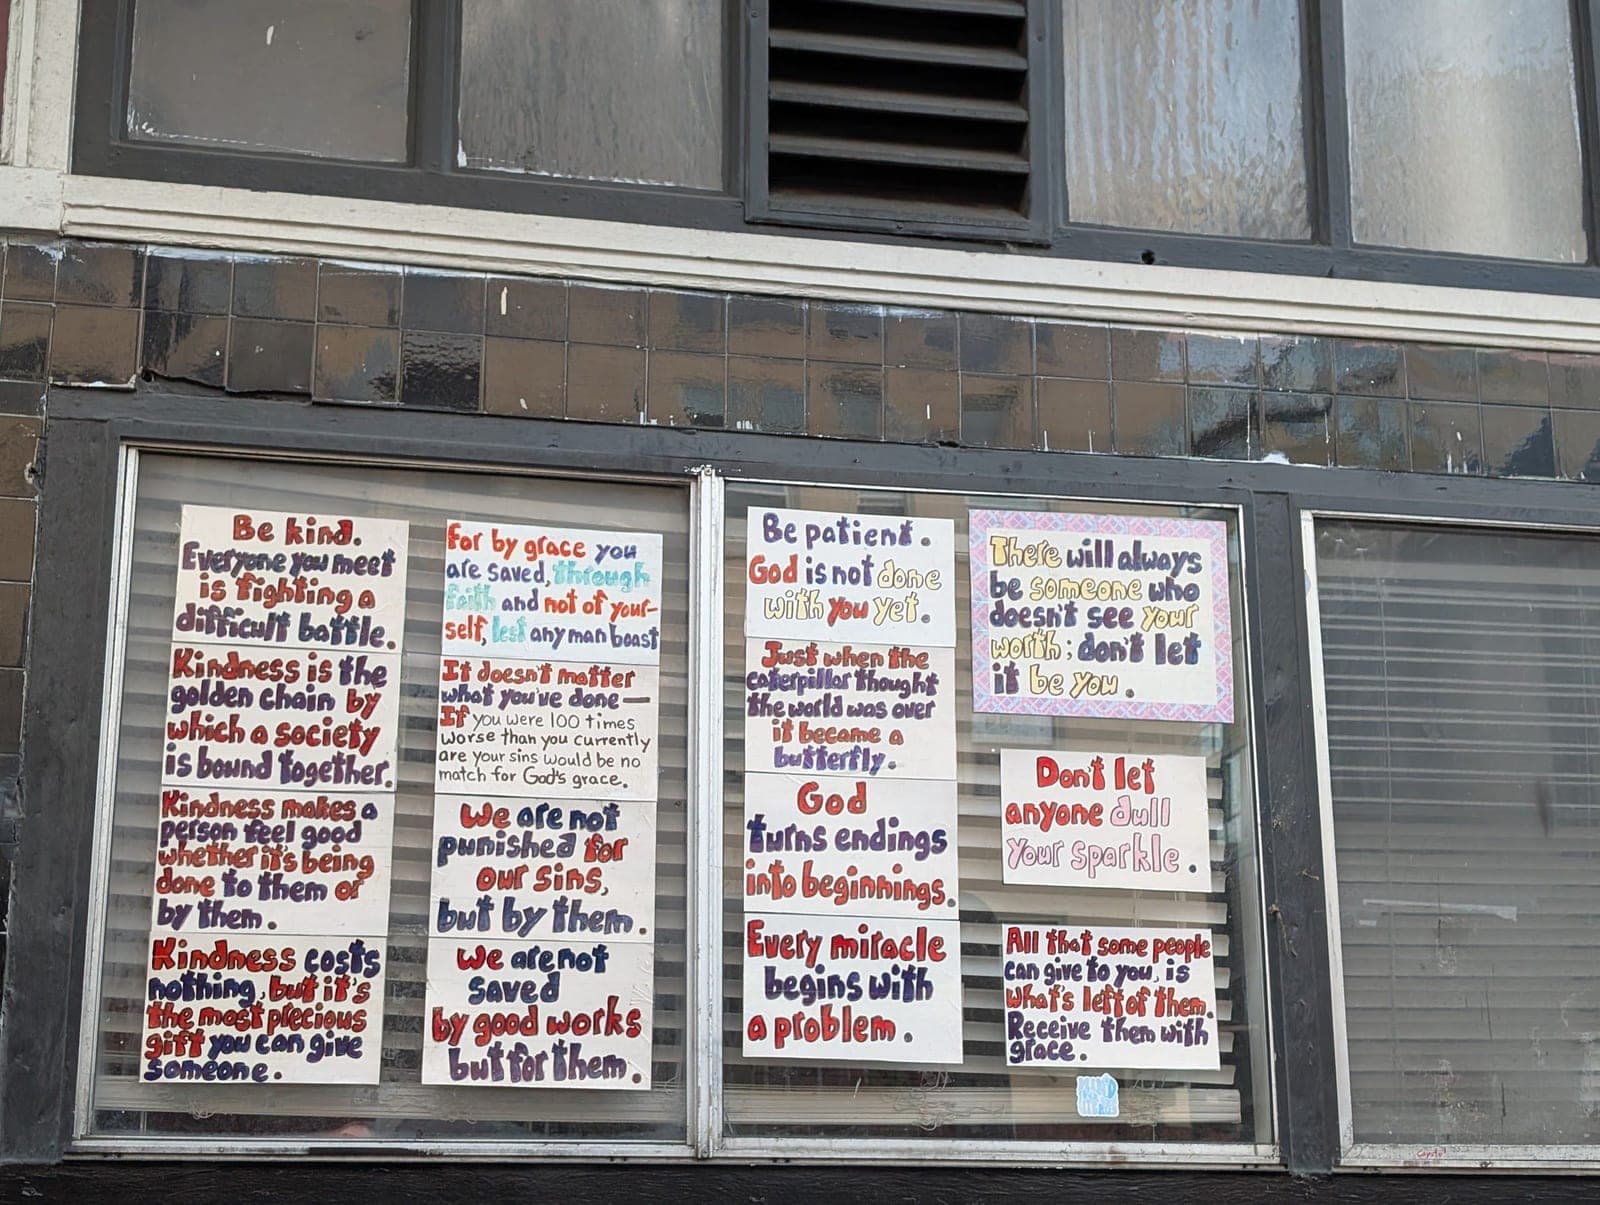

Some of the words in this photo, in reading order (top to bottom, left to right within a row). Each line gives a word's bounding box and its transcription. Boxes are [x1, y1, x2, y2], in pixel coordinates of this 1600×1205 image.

[233, 515, 274, 541] Be
[285, 517, 362, 546] kind.
[763, 512, 797, 543] Be
[182, 541, 286, 578] Everyone
[290, 552, 329, 577] you
[332, 549, 396, 576] meet
[492, 529, 518, 560] by
[524, 536, 586, 561] grace
[595, 543, 637, 564] you
[990, 536, 1062, 568] There
[1066, 538, 1114, 569] will
[1117, 540, 1203, 577] always
[447, 559, 481, 579] are
[488, 561, 551, 587] saved,
[749, 554, 798, 585] God
[806, 557, 827, 585] is
[832, 555, 874, 586] not
[877, 560, 941, 590] done
[989, 570, 1023, 601] be
[1029, 576, 1142, 601] someone
[1149, 576, 1200, 602] who
[200, 573, 226, 601] is
[236, 573, 352, 614] fighting
[501, 588, 539, 612] and
[544, 589, 578, 614] not
[582, 590, 608, 615] of
[765, 588, 824, 620] with
[827, 597, 869, 627] you
[176, 603, 291, 642] difficult
[299, 613, 396, 650] battle.
[445, 615, 487, 646] self,
[609, 623, 659, 650] boast
[989, 600, 1078, 628] doesn't
[1087, 606, 1134, 629] see
[1141, 604, 1199, 632] your
[761, 640, 817, 668] Just
[824, 646, 884, 668] when
[889, 646, 929, 670] the
[1077, 631, 1144, 663] don't
[1155, 632, 1202, 665] let
[172, 649, 300, 683] Kindness
[308, 652, 332, 683] is
[339, 656, 387, 688] the
[442, 659, 473, 682] It
[478, 661, 552, 684] doesn't
[557, 665, 635, 688] matter
[746, 667, 851, 696] caterpillar
[854, 668, 939, 699] thought
[992, 660, 1020, 695] it
[1030, 664, 1064, 696] be
[171, 680, 254, 713] golden
[259, 684, 335, 711] chain
[346, 689, 382, 720] by
[441, 683, 494, 705] what
[500, 688, 562, 710] you've
[747, 693, 785, 718] the
[788, 693, 843, 718] world
[847, 701, 888, 719] was
[892, 700, 935, 720] over
[168, 711, 245, 744] which
[274, 716, 380, 756] society
[440, 705, 471, 728] If
[472, 714, 501, 731] you
[507, 715, 544, 727] were
[551, 712, 579, 729] 100
[586, 713, 635, 730] times
[772, 719, 794, 743] it
[799, 721, 881, 745] became
[501, 729, 536, 745] than
[541, 735, 568, 751] you
[574, 733, 650, 752] currently
[165, 743, 192, 777] is
[197, 746, 272, 779] bound
[278, 750, 393, 788] together.
[439, 750, 466, 762] are
[472, 752, 506, 766] your
[509, 749, 538, 764] sins
[544, 752, 591, 767] would
[597, 753, 615, 768] be
[621, 756, 640, 768] no
[1036, 755, 1105, 790] Don't
[1115, 757, 1155, 795] let
[439, 765, 486, 782] match
[491, 765, 516, 782] for
[523, 766, 566, 785] God's
[573, 775, 628, 789] grace.
[162, 790, 275, 820] Kindness
[281, 796, 356, 821] makes
[797, 781, 867, 815] God
[1006, 801, 1104, 832] anyone
[1110, 795, 1171, 827] dull
[517, 802, 563, 830] are
[569, 803, 620, 832] not
[160, 820, 238, 848] person
[244, 819, 296, 843] feel
[301, 820, 362, 850] good
[437, 830, 576, 867] punished
[584, 833, 628, 863] for
[747, 814, 827, 853] turns
[835, 817, 948, 861] endings
[158, 840, 258, 869] whether
[260, 845, 297, 871] it's
[302, 845, 374, 879] being
[156, 868, 215, 896] done
[222, 869, 252, 897] to
[258, 872, 328, 902] them
[335, 879, 364, 901] or
[476, 864, 529, 892] our
[533, 863, 608, 896] sins,
[746, 858, 797, 900] into
[801, 860, 956, 910] beginnings.
[157, 899, 192, 930] by
[437, 895, 494, 932] but
[502, 896, 547, 938] by
[152, 938, 296, 972] Kindness
[304, 939, 381, 978] costs
[511, 946, 554, 971] are
[558, 944, 609, 973] not
[747, 919, 823, 968] Every
[830, 923, 947, 962] miracle
[1006, 927, 1039, 954] All
[1046, 929, 1093, 956] that
[1097, 936, 1148, 958] some
[1153, 934, 1211, 963] people
[765, 963, 863, 1006] begins
[868, 964, 934, 1003] with
[1004, 960, 1040, 982] can
[1044, 957, 1082, 986] give
[1086, 956, 1110, 983] to
[1166, 958, 1190, 983] is
[269, 974, 318, 1002] but
[324, 975, 371, 1004] it's
[1083, 984, 1124, 1018] left
[1125, 986, 1150, 1017] of
[1154, 984, 1214, 1018] them.
[146, 1002, 193, 1030] the
[198, 1000, 264, 1032] most
[267, 1002, 367, 1035] precious
[432, 1006, 469, 1046] by
[473, 1004, 538, 1046] good
[546, 996, 642, 1038] works
[1008, 1010, 1091, 1040] Receive
[1101, 1016, 1155, 1044] them
[1160, 1018, 1209, 1047] with
[144, 1029, 205, 1060] gift
[208, 1034, 250, 1060] you
[255, 1034, 304, 1055] can
[306, 1030, 363, 1063] give
[449, 1041, 504, 1082] but
[506, 1042, 549, 1082] for
